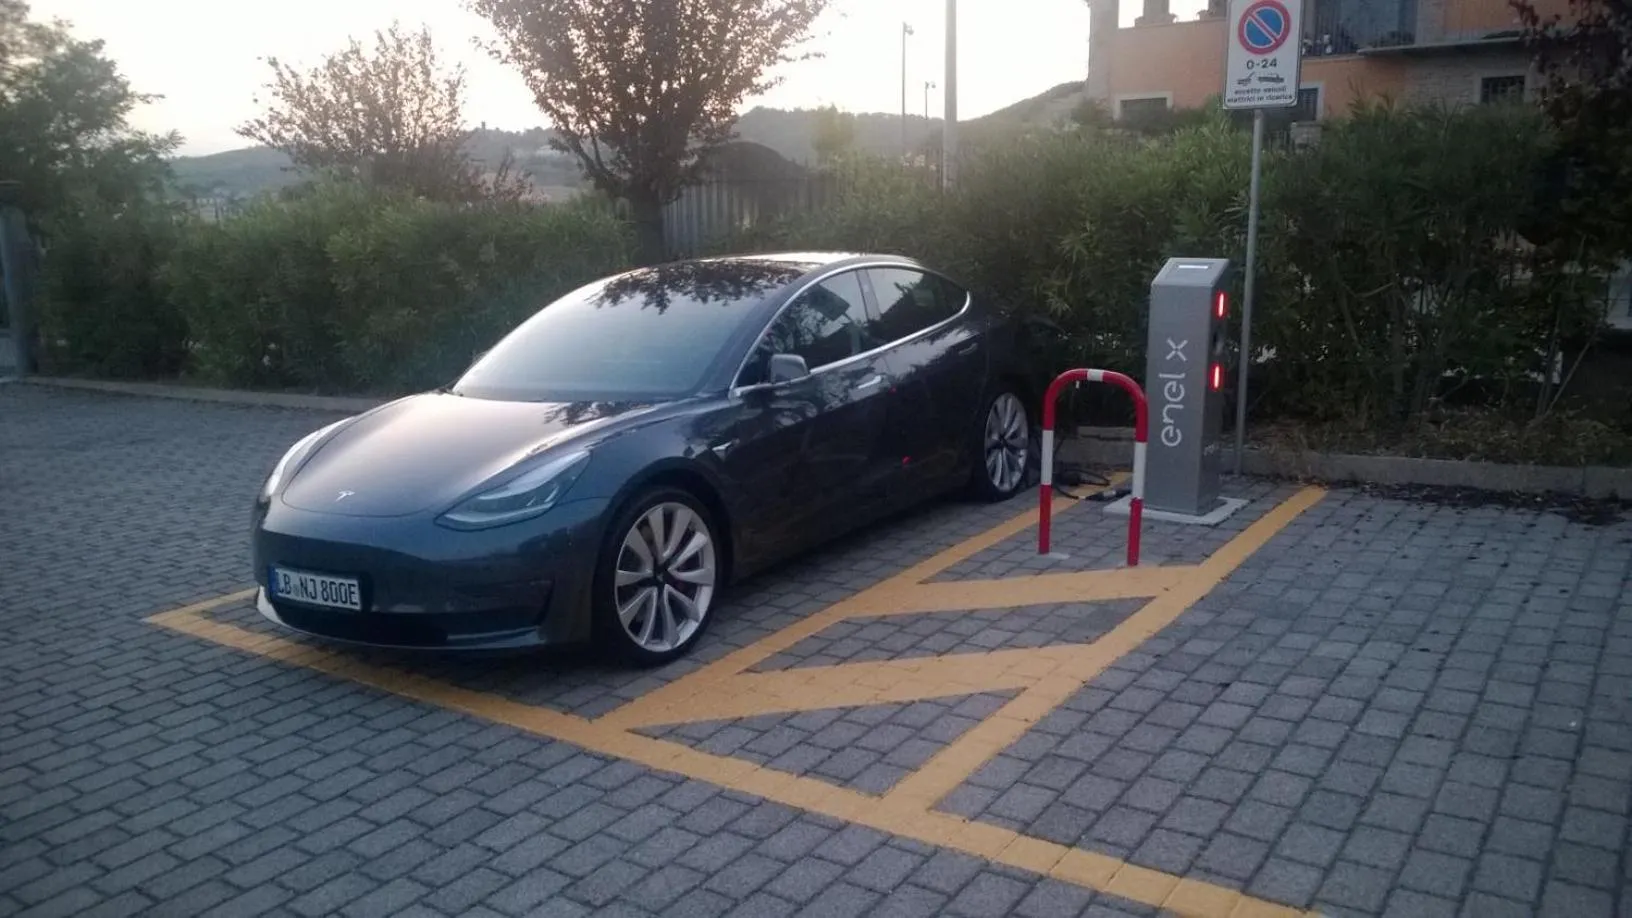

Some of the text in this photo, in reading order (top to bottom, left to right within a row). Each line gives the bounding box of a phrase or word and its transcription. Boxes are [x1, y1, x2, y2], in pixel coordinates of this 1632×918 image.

[1246, 57, 1278, 70] 0-24
[1158, 372, 1186, 447] enel
[299, 575, 318, 600] NJ
[320, 580, 359, 606] 800E
